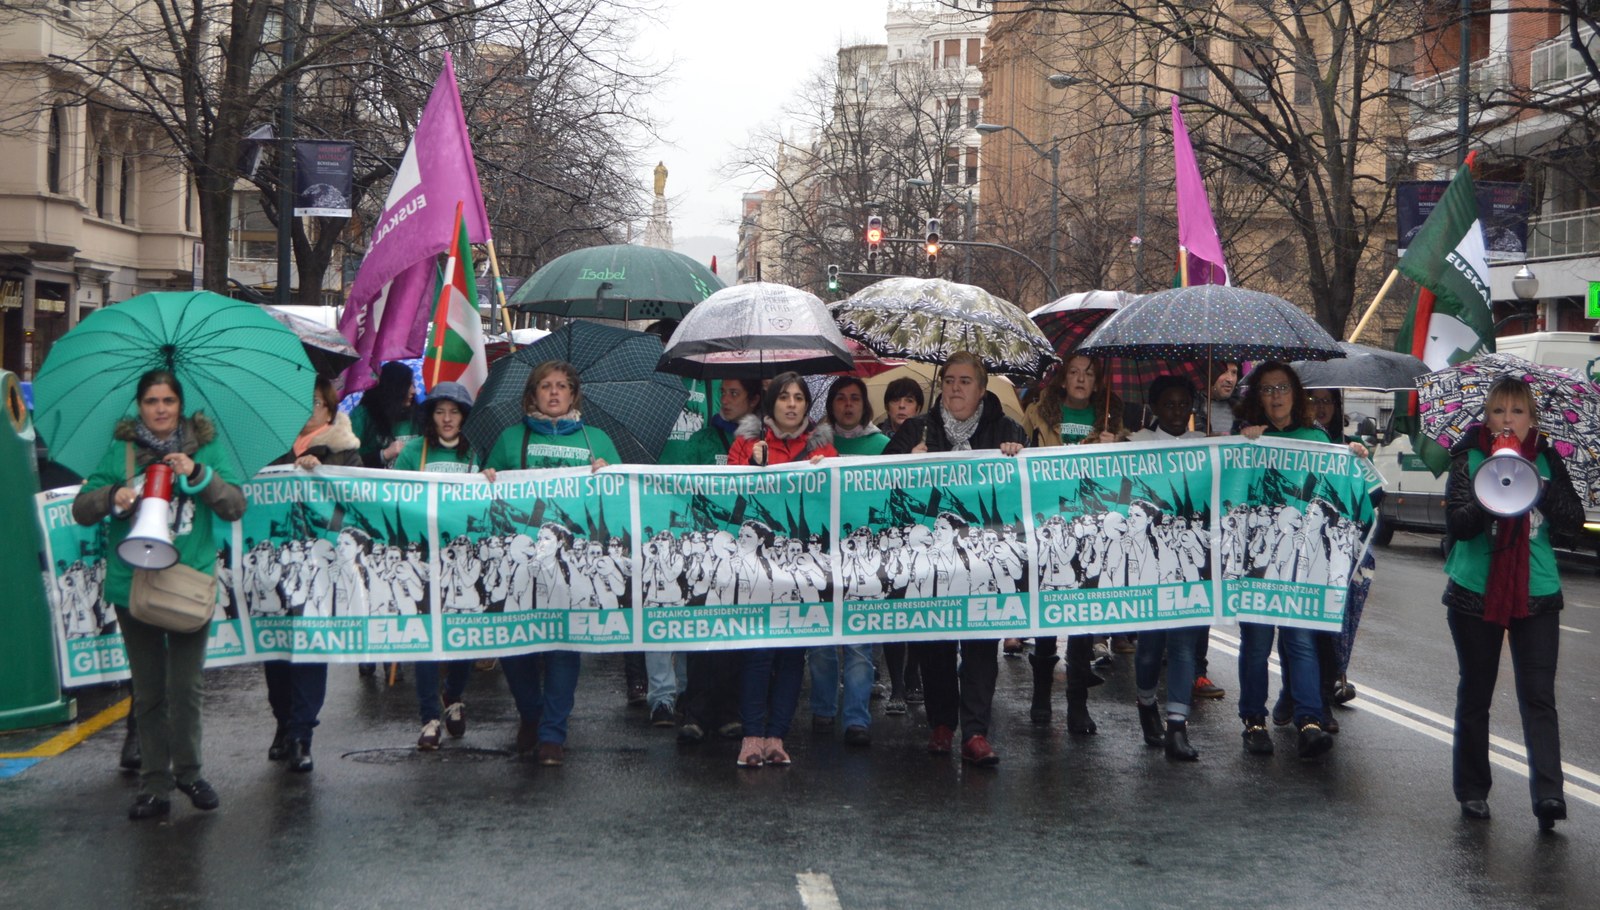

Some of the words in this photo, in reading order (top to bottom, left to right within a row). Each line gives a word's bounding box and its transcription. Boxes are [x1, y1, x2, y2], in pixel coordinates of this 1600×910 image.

[577, 266, 626, 281] Isabel
[1031, 452, 1164, 482] PREKARIETATEARI
[1167, 450, 1206, 473] STOP
[1223, 448, 1350, 476] PREKARIETATEARI
[442, 478, 580, 501] PREKARIETATEARI
[585, 474, 625, 496] STOP
[643, 472, 781, 495] PREKARIETATEARI
[787, 472, 827, 494] STOP
[844, 465, 972, 492] PREKARIETATEARI
[977, 462, 1014, 485] STOP
[243, 480, 377, 505] PREKARIETATEARI
[382, 482, 424, 503] STOP
[1044, 593, 1085, 602] BIZKAIKO
[1087, 588, 1153, 600] ERRESIDENTZIAK
[1157, 584, 1210, 611] ELA
[1252, 582, 1320, 595] ERRESIDENTZIAK
[693, 607, 764, 616] ERRESIDENTZIAK
[769, 605, 830, 628] ELA
[848, 603, 890, 611] BIZKAIKO
[893, 600, 962, 609] ERRESIDENTZIAK
[968, 596, 1027, 621] ELA
[1044, 599, 1154, 624] GREBAN!!
[292, 620, 362, 628] ERRESIDENTZIAK
[447, 617, 489, 625] BIZKAIKO
[493, 612, 564, 624] ERRESIDENTZIAK
[569, 611, 630, 635] ELA
[648, 617, 764, 639] GREBAN!!
[848, 609, 962, 631] GREBAN!!
[368, 618, 429, 643] ELA
[448, 621, 564, 648] GREBAN!!
[793, 627, 830, 635] SINDIKATUA
